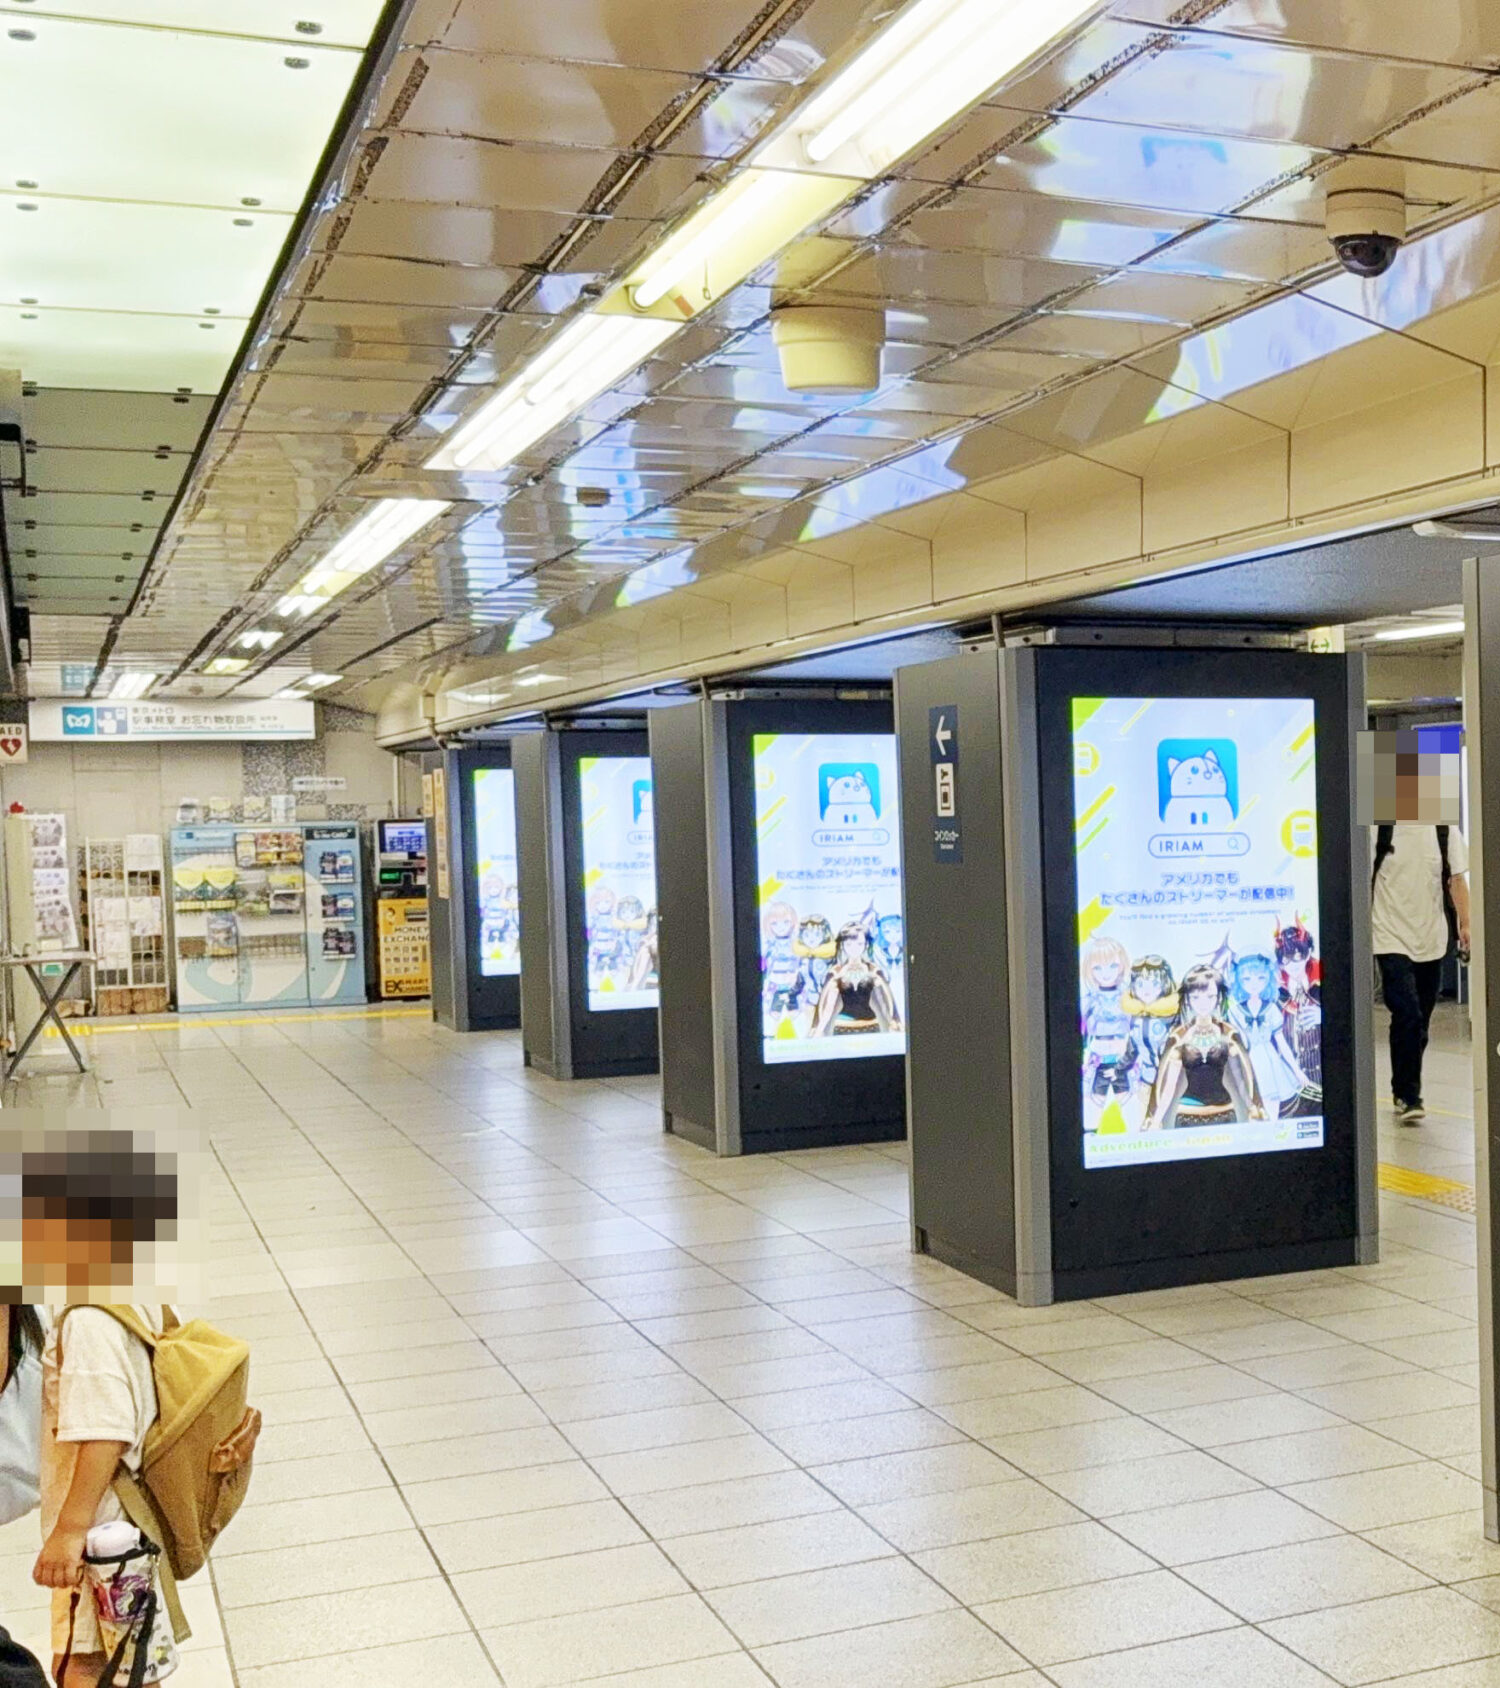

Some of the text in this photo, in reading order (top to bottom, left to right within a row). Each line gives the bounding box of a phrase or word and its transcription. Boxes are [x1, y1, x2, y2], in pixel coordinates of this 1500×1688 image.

[0, 726, 23, 736] AED
[820, 834, 854, 842] IRIAM
[1159, 840, 1204, 853] IRIAM
[1162, 872, 1239, 886] アメリカでも
